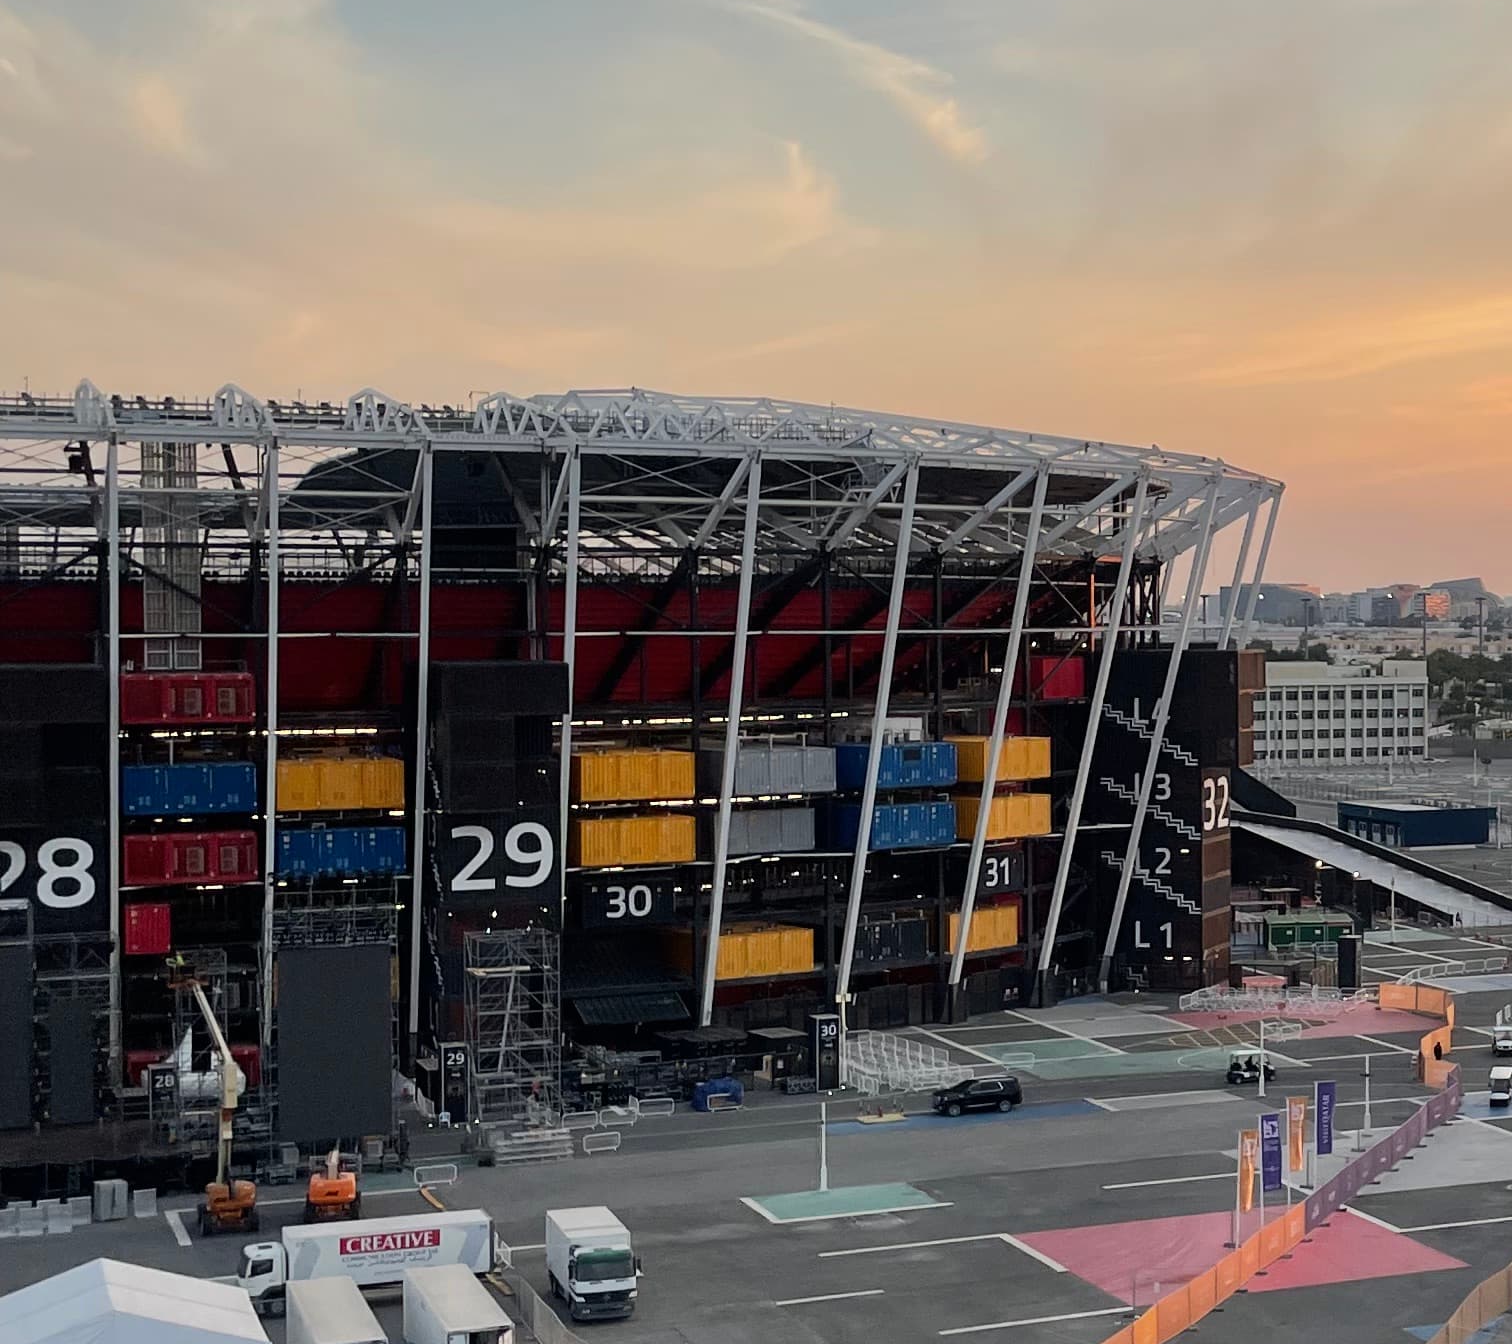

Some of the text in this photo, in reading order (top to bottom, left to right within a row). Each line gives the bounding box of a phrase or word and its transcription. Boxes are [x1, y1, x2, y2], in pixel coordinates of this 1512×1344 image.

[1203, 775, 1229, 831] 32
[451, 822, 554, 892] 29
[985, 857, 1010, 887] 31
[606, 885, 653, 919] 30
[820, 1024, 837, 1037] 30
[446, 1052, 465, 1066] 29
[154, 1075, 174, 1089] 28
[345, 1231, 433, 1253] CREATIVE
